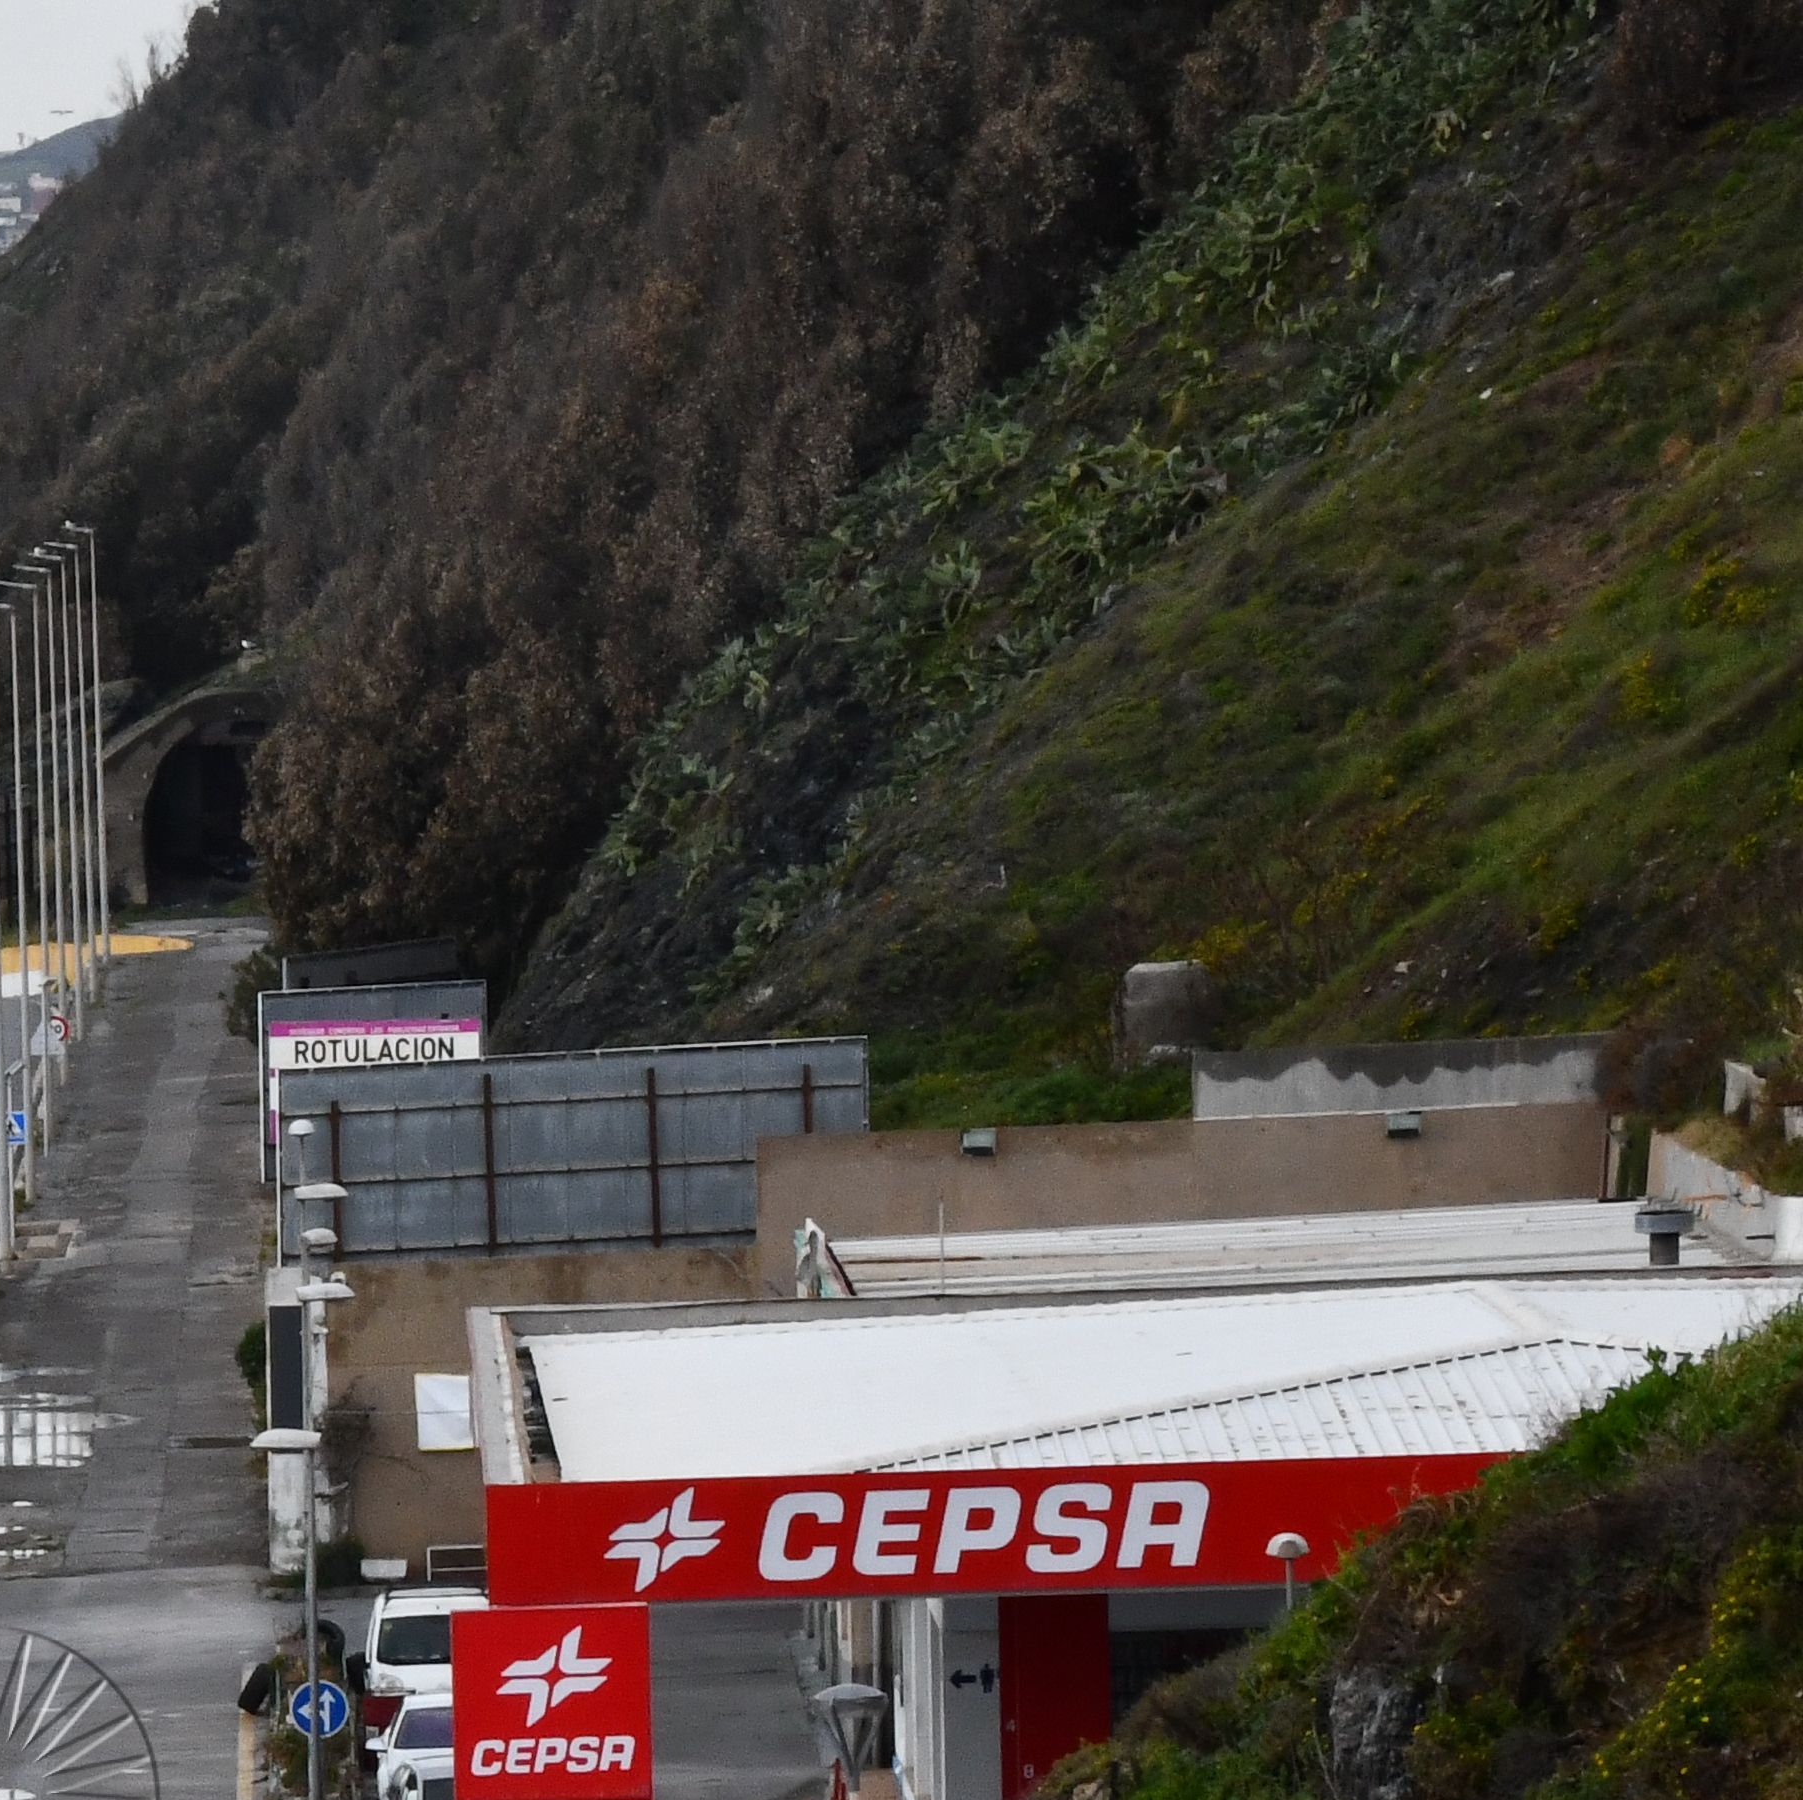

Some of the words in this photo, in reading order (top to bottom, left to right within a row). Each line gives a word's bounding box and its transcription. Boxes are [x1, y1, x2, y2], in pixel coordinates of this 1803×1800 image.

[293, 1036, 455, 1065] ROTULACION
[757, 1478, 1212, 1582] CEPSA
[470, 1735, 636, 1777] CEPSA
